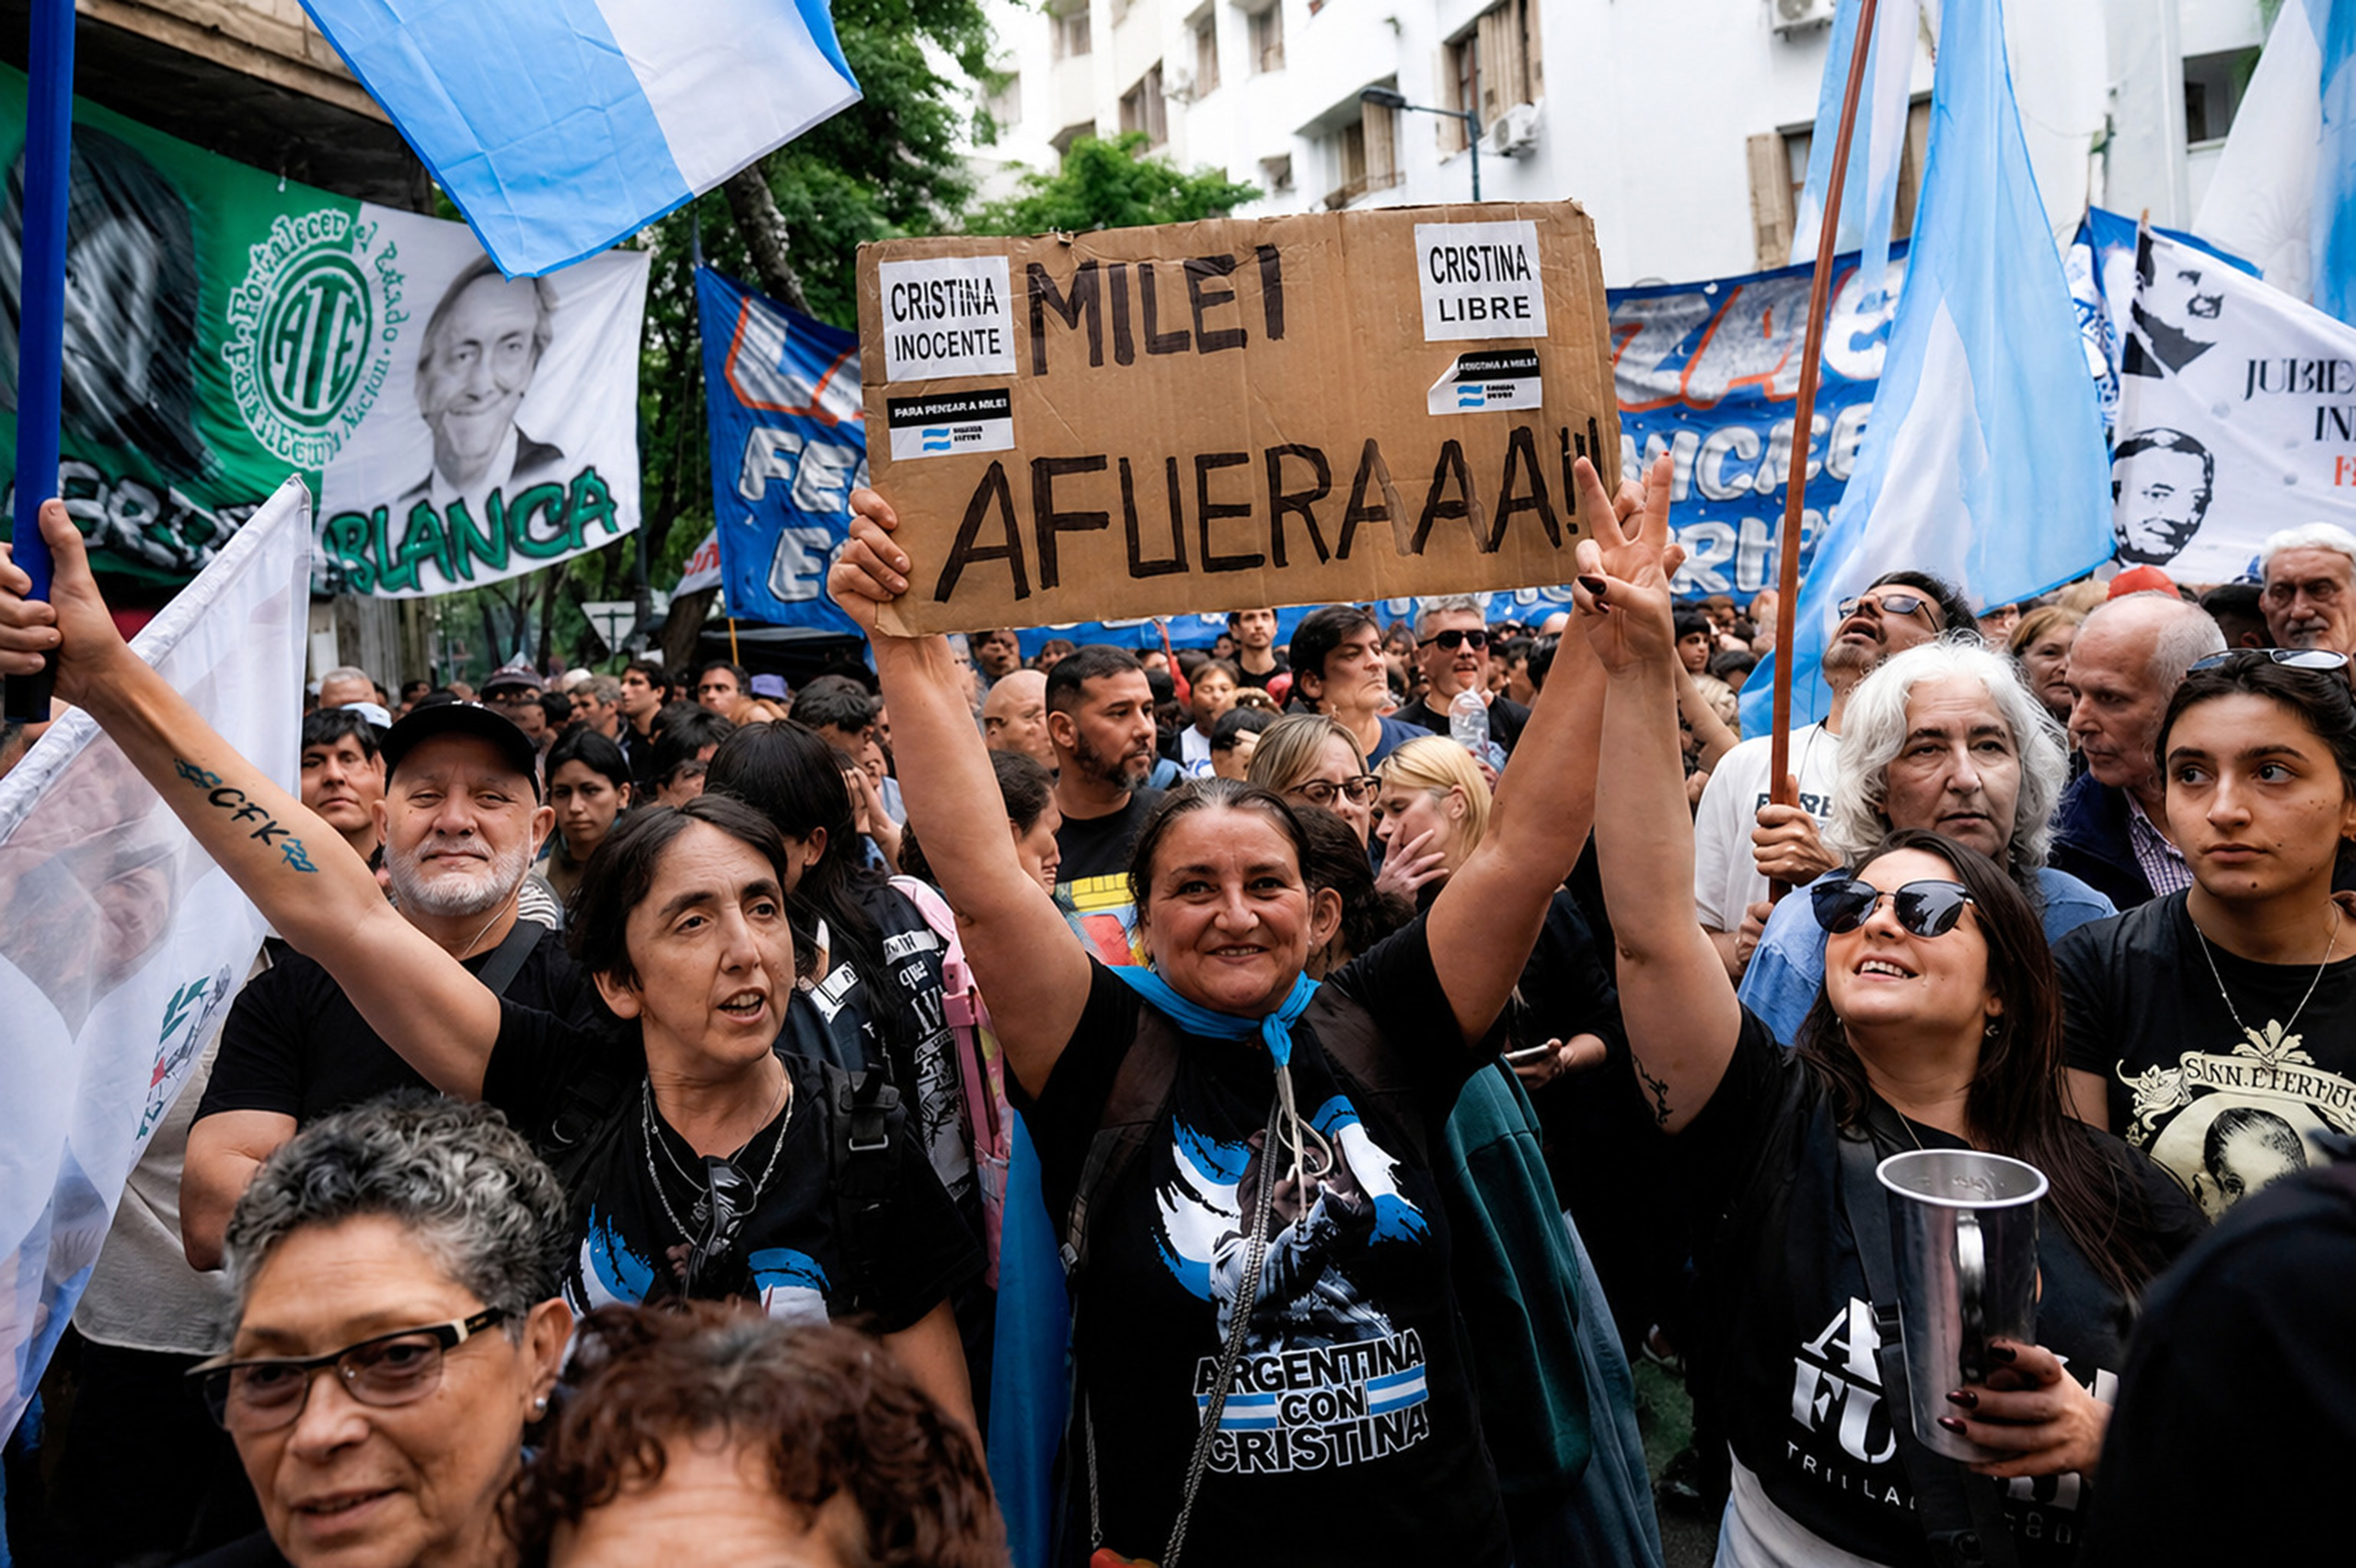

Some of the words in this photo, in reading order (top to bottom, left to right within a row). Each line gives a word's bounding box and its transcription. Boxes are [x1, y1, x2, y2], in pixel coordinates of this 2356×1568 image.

[1428, 244, 1532, 284] CRISTINA
[890, 277, 999, 322] CRISTINA
[1026, 242, 1285, 376] MILEI
[1438, 295, 1532, 322] LIBRE
[275, 272, 364, 410] ATE
[894, 328, 1002, 362] INOCENTE
[323, 466, 619, 594] BLANCA
[208, 787, 291, 847] CFK
[1193, 1328, 1426, 1397] ARGENTINA
[1278, 1381, 1368, 1429] CON
[1204, 1403, 1430, 1474] CRISTINA
